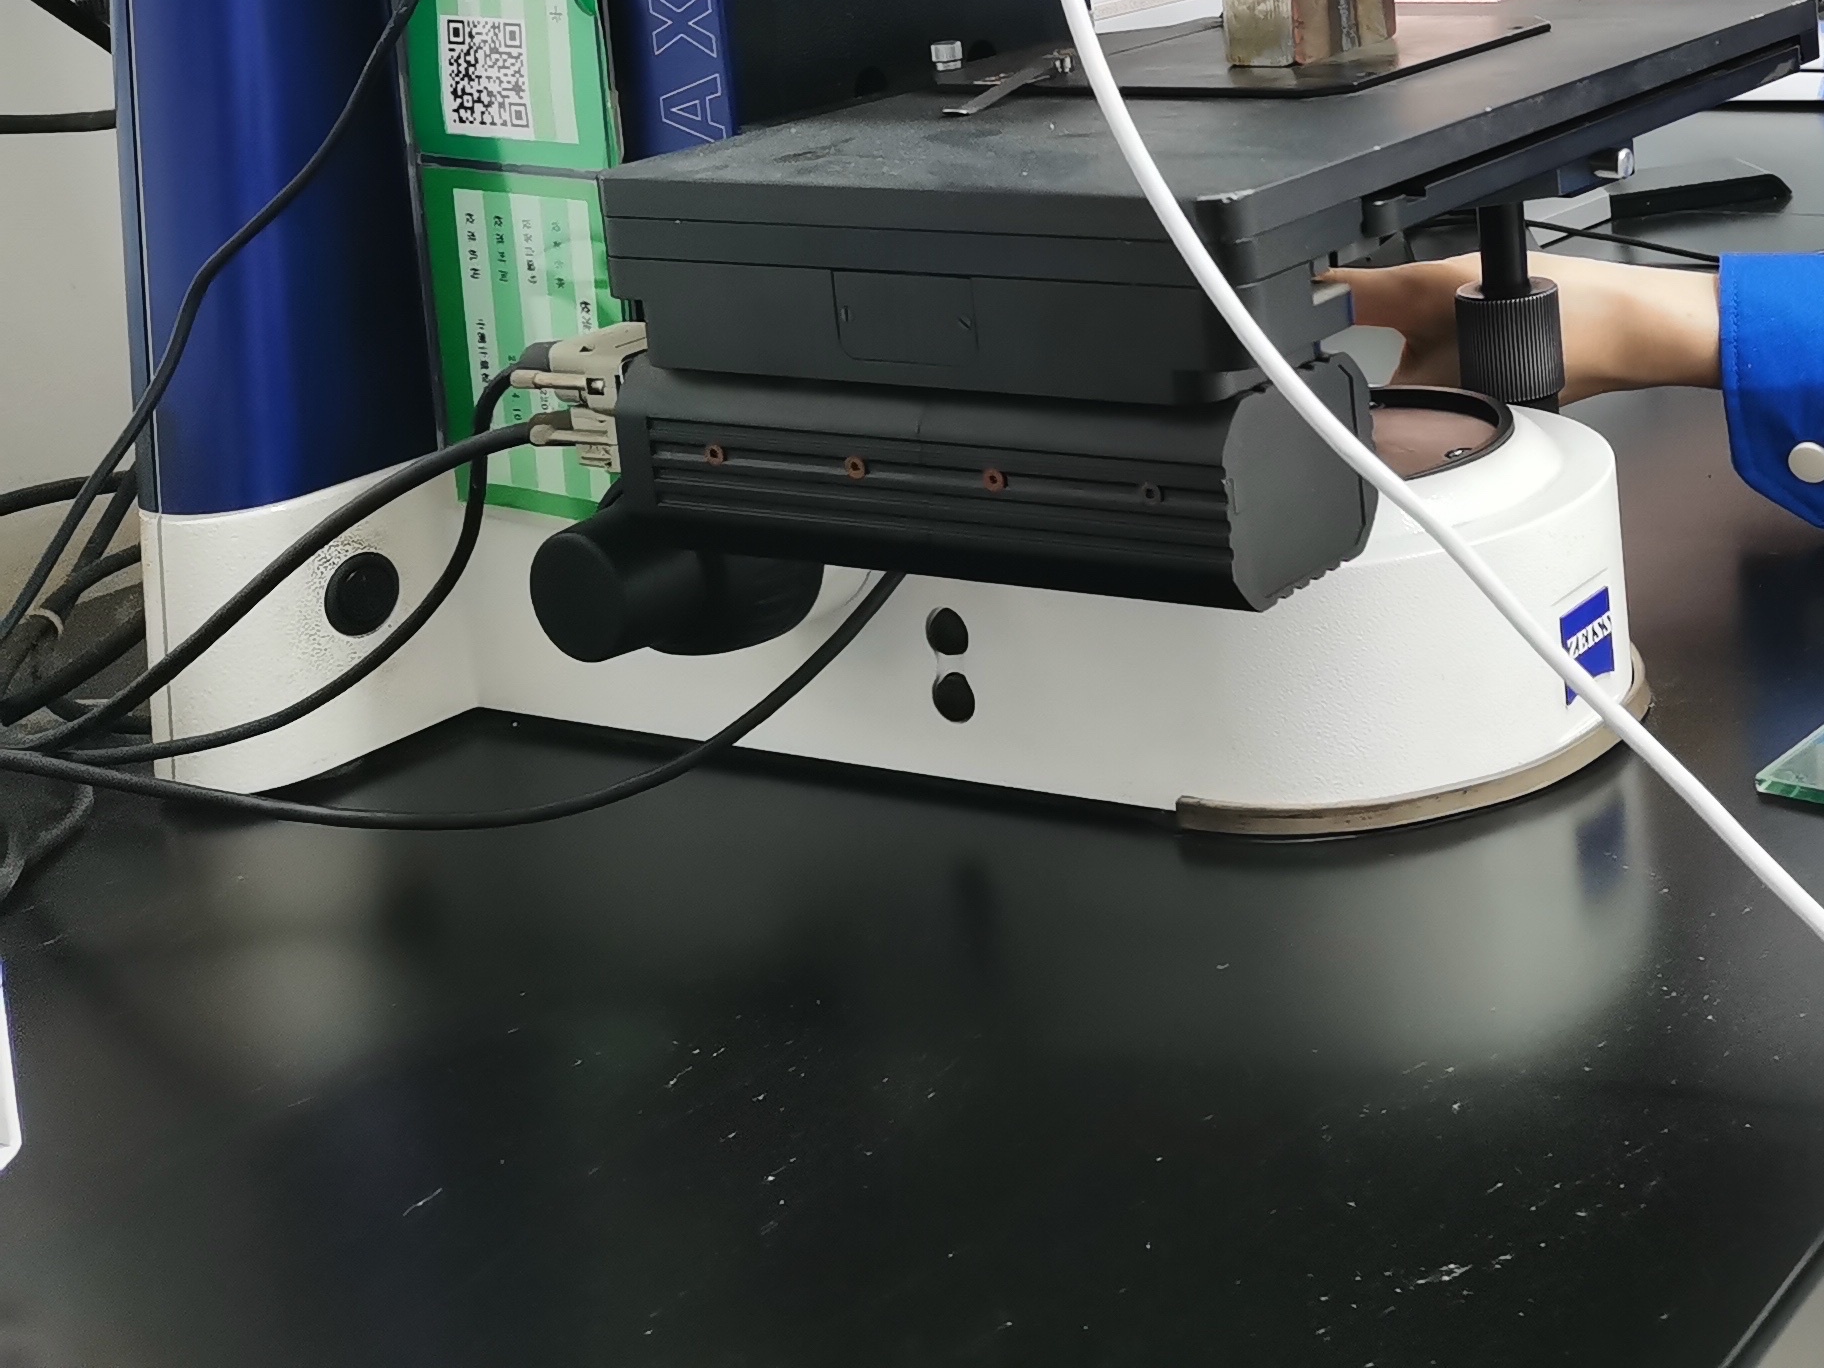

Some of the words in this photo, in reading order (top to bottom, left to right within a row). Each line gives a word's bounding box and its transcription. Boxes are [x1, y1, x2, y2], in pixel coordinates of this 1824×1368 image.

[464, 212, 481, 280] 校准机构
[493, 215, 510, 283] 校准时间
[1566, 610, 1613, 659] ZEISS
